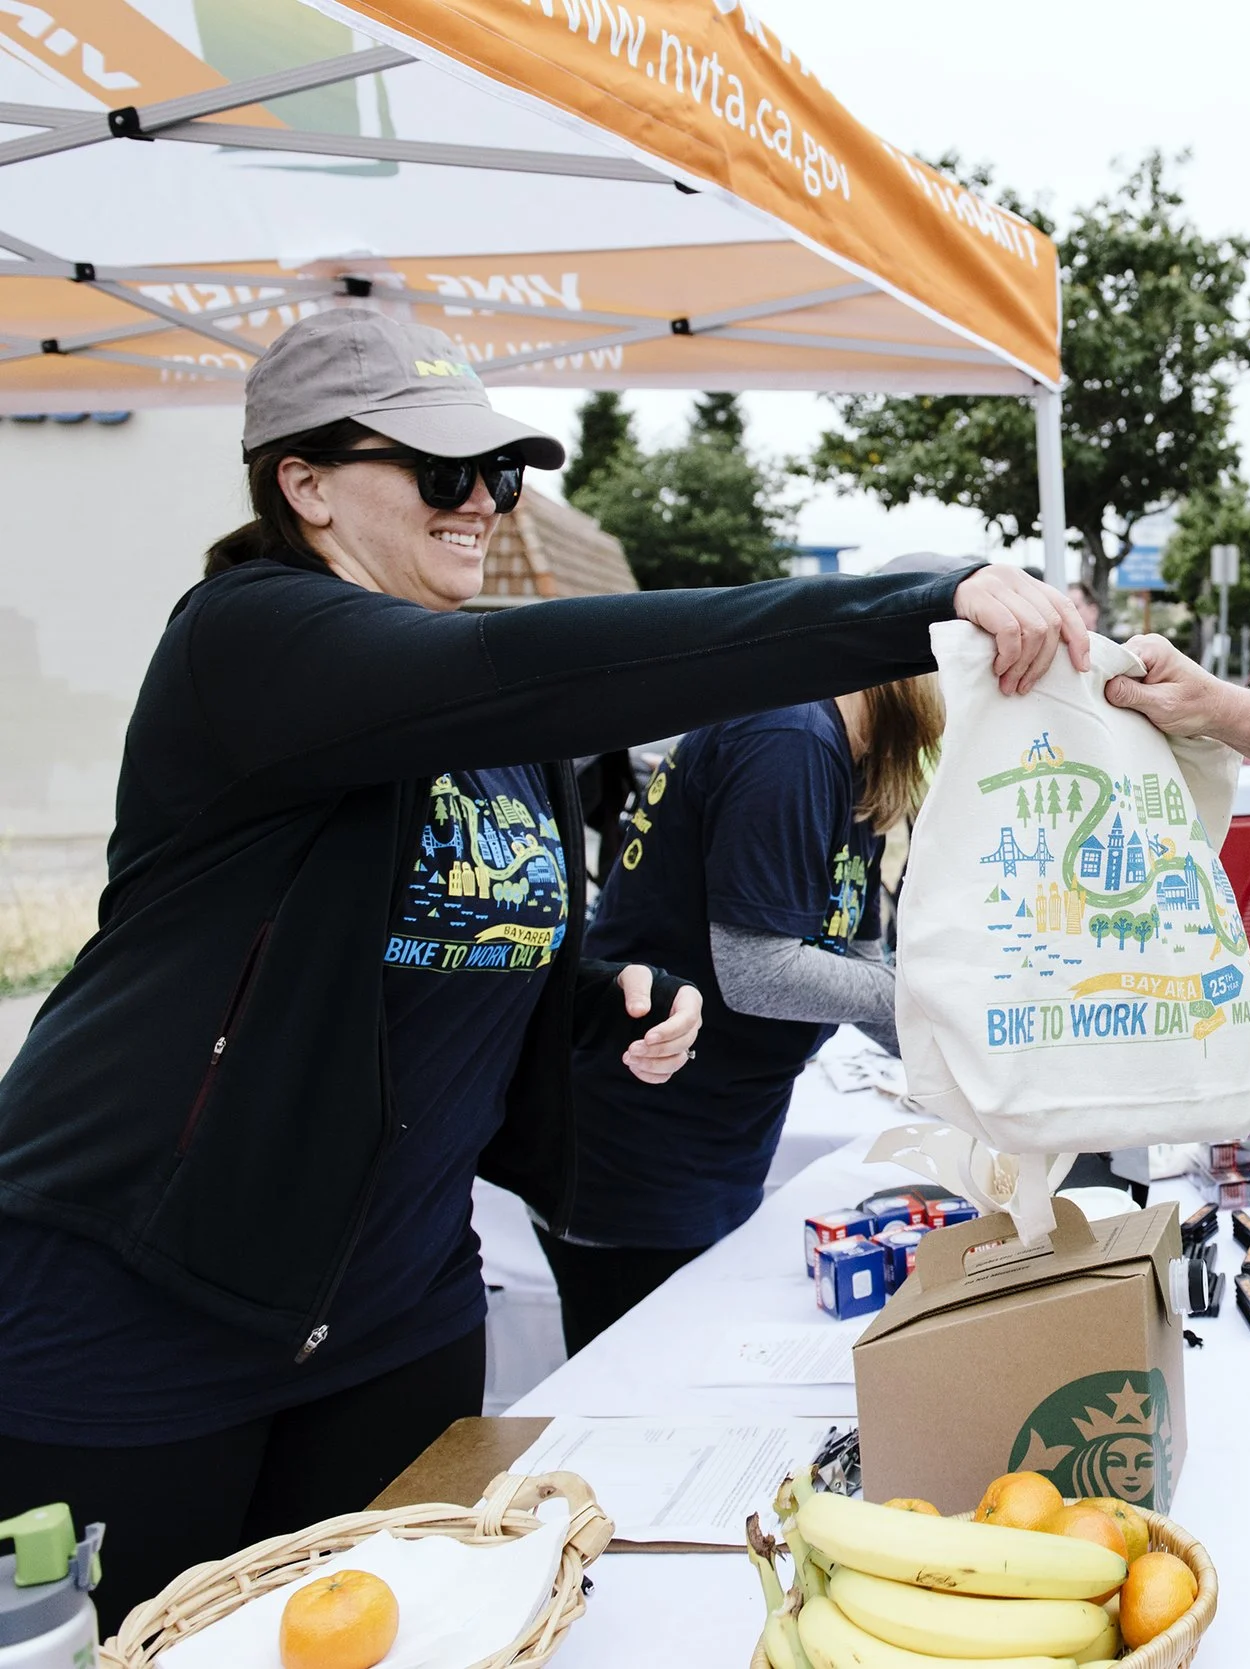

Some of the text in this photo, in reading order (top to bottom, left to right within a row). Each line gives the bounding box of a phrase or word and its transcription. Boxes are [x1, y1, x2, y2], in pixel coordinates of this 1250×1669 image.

[522, 0, 850, 201] ww.nvta.ca.gov
[503, 925, 525, 939] BAY
[523, 930, 551, 945] AREA
[383, 937, 538, 969] BIKE TO WORK DAY
[1120, 974, 1161, 993] BAY
[1226, 980, 1240, 992] YEAR
[987, 1005, 1036, 1047] BIKE
[1039, 1004, 1064, 1041] TO
[1070, 1002, 1149, 1038] WORK
